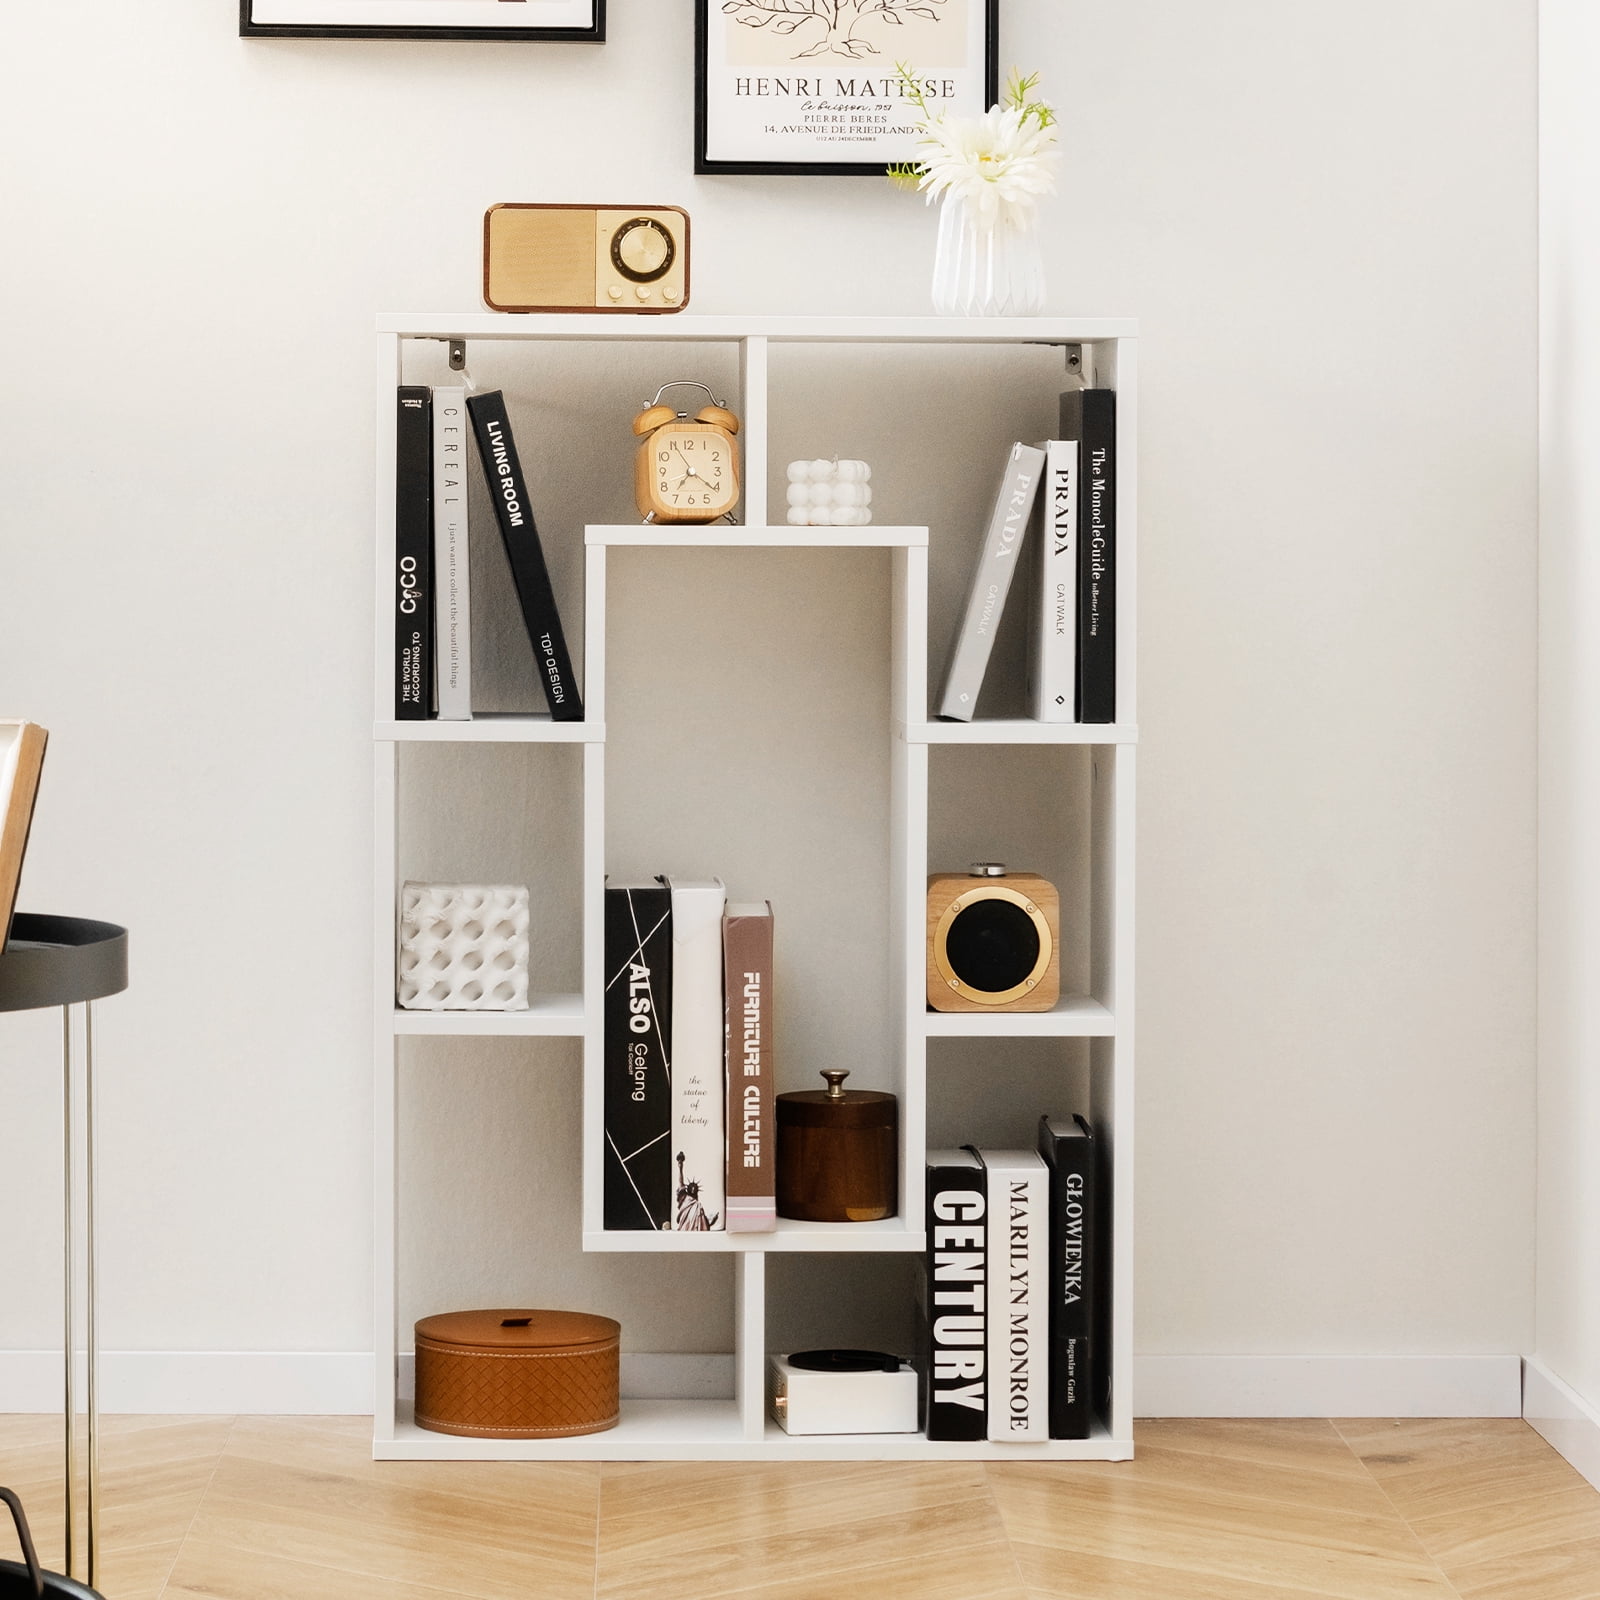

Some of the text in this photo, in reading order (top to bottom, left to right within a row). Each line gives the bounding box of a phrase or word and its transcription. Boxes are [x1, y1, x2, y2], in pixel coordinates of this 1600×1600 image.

[735, 78, 956, 98] HENRI MATISSE
[764, 125, 778, 134] 14,
[780, 126, 828, 134] AVENUE
[831, 126, 847, 134] DE
[849, 126, 914, 134] FRIEDLAND
[444, 408, 459, 504] CEREAL
[684, 440, 694, 450] 12
[658, 452, 670, 462] 10
[712, 452, 720, 462] 2
[487, 421, 524, 526] LIVING ROOM
[660, 467, 666, 477] 9
[714, 466, 722, 477] 3
[660, 482, 668, 492] 8
[713, 482, 720, 492] 4
[672, 494, 679, 504] 7
[688, 494, 695, 504] 6
[703, 494, 711, 504] 5
[996, 472, 1032, 558] PRADA
[1054, 468, 1069, 556] PRADA
[1092, 447, 1106, 580] The MonocleGuide
[448, 526, 456, 544] just
[450, 568, 456, 577] to
[977, 584, 998, 634] CATWALK
[1056, 583, 1064, 635] CATWALK
[1090, 613, 1099, 636] Living
[451, 622, 459, 660] beautiful
[450, 662, 459, 688] things
[540, 632, 564, 704] TOP DESIGN
[628, 963, 650, 1033] ALSO
[632, 1043, 648, 1102] Gelang
[689, 1075, 702, 1084] the
[690, 1099, 700, 1110] of
[744, 1086, 761, 1168] CULTURE
[1064, 1174, 1084, 1304] GŁOWIENKA
[933, 1190, 986, 1411] CENTURY
[1010, 1180, 1029, 1430] MARILYN MONROE
